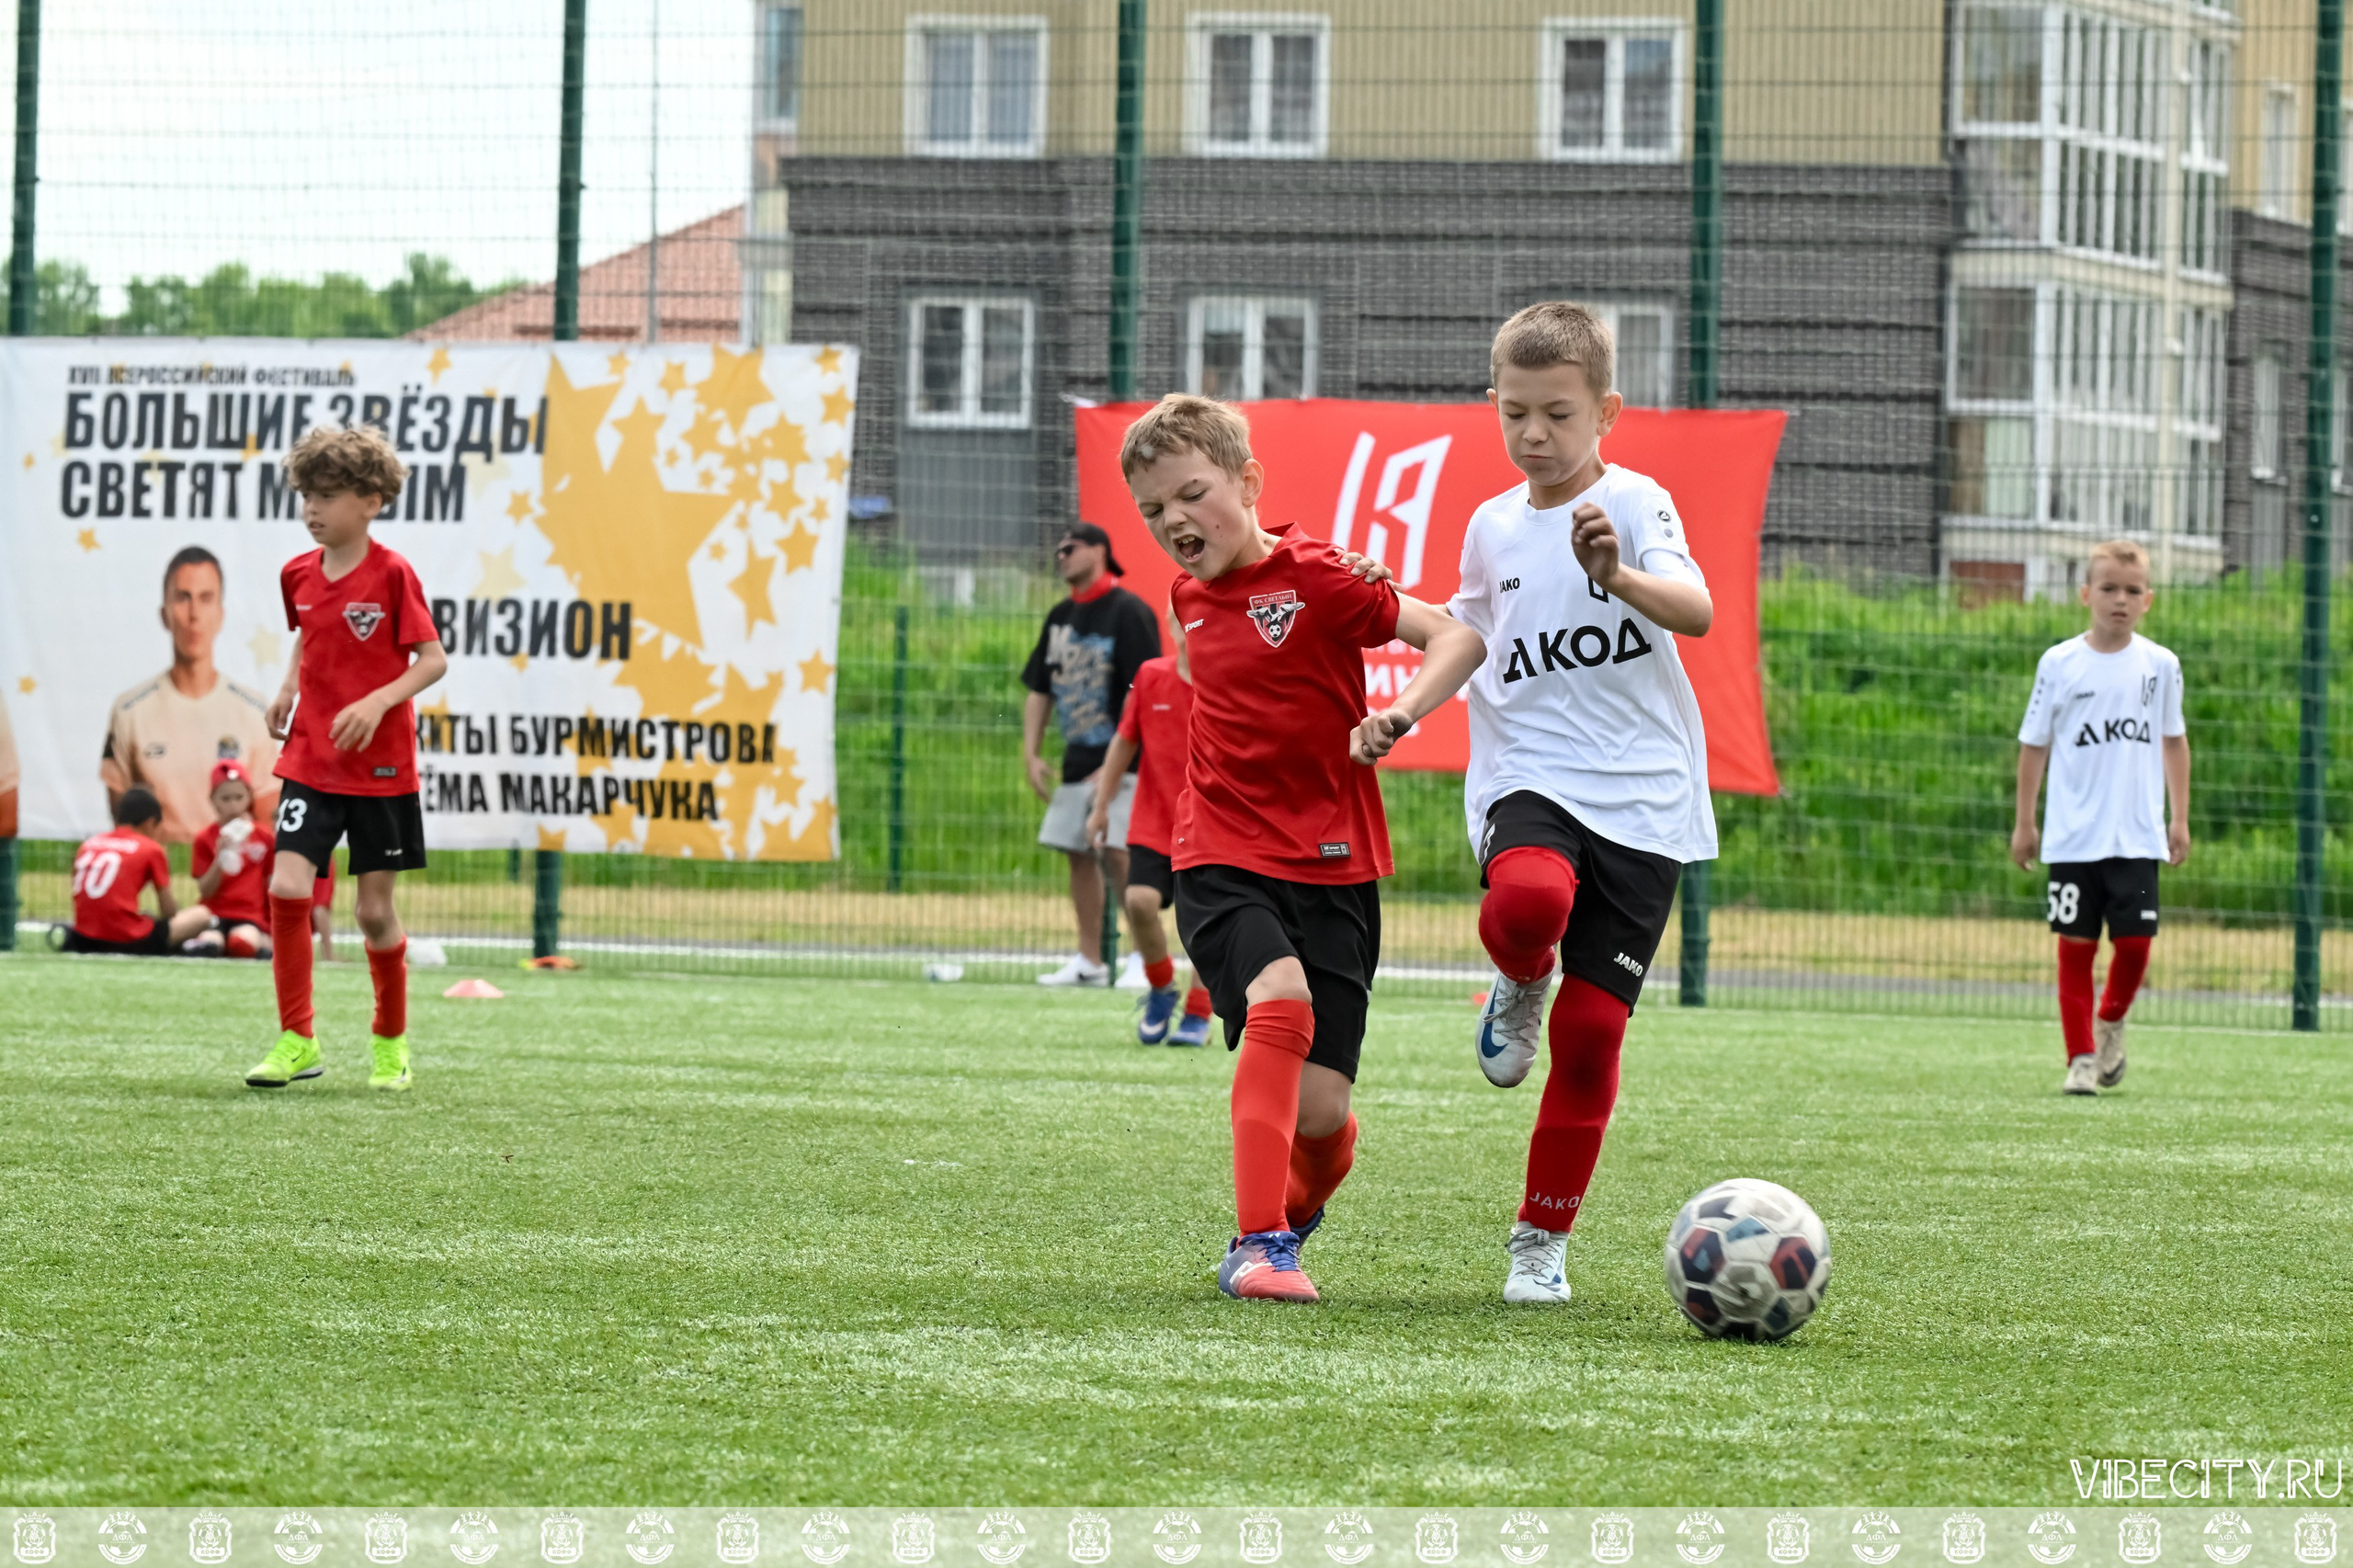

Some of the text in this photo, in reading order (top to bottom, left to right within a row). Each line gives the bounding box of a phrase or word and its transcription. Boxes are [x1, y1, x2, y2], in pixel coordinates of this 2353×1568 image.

[65, 383, 548, 464] БОЛЬШИЕ ЗВЁЗДЫ
[61, 460, 242, 518] СВЕТЯТ
[432, 598, 632, 660] ВИЗИОН
[423, 764, 719, 821] ЁМА МАКАРЧУКА
[73, 850, 122, 900] 10
[2046, 881, 2080, 925] 58
[1614, 952, 1643, 978] JAKO
[1529, 1192, 1581, 1210] JAKO
